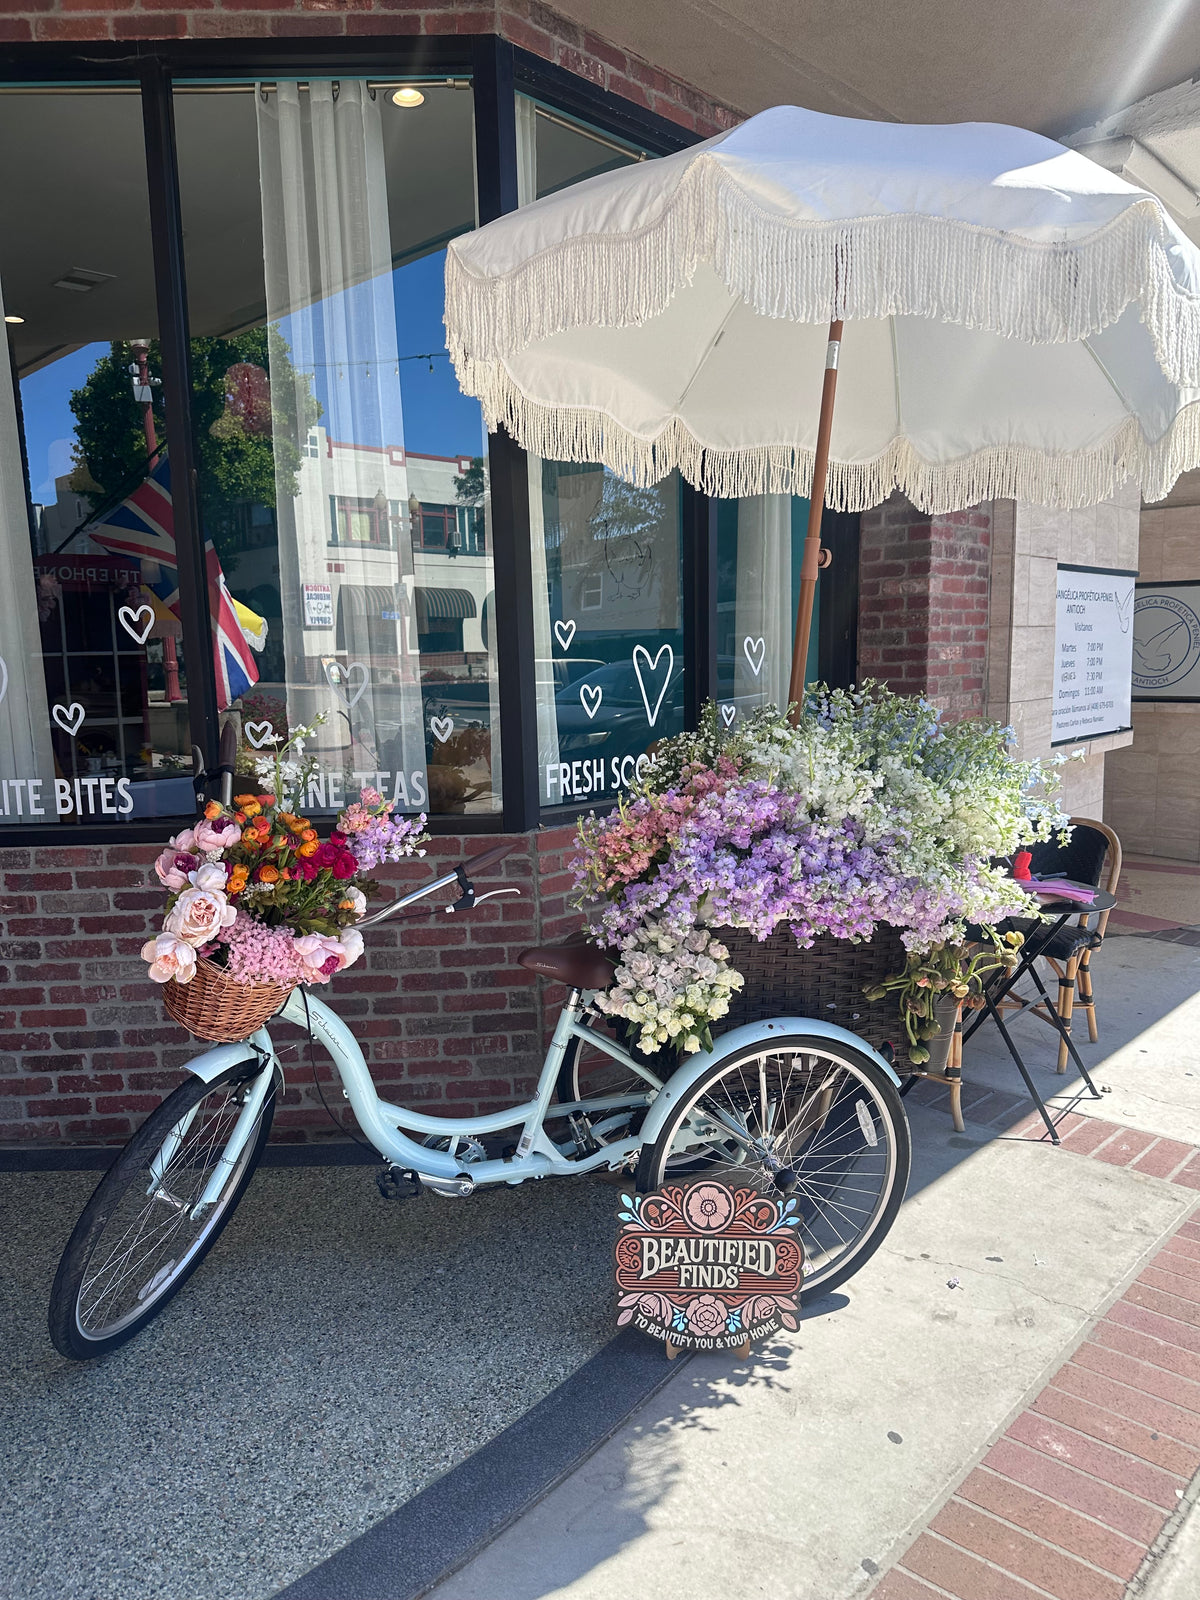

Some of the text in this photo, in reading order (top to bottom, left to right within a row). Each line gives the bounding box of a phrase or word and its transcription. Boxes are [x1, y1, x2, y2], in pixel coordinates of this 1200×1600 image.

[1134, 676, 1169, 686] ANTIOCH
[352, 770, 426, 807] TEAS
[545, 752, 658, 799] FRESH SCO
[54, 777, 134, 815] BITES
[639, 1237, 777, 1280] BEAUTIFIED
[678, 1265, 739, 1289] FINDS
[634, 1313, 648, 1329] TO
[646, 1322, 693, 1348] BEAUTIFY
[694, 1337, 714, 1349] YOU
[715, 1337, 724, 1349] &
[749, 1318, 779, 1341] HOME
